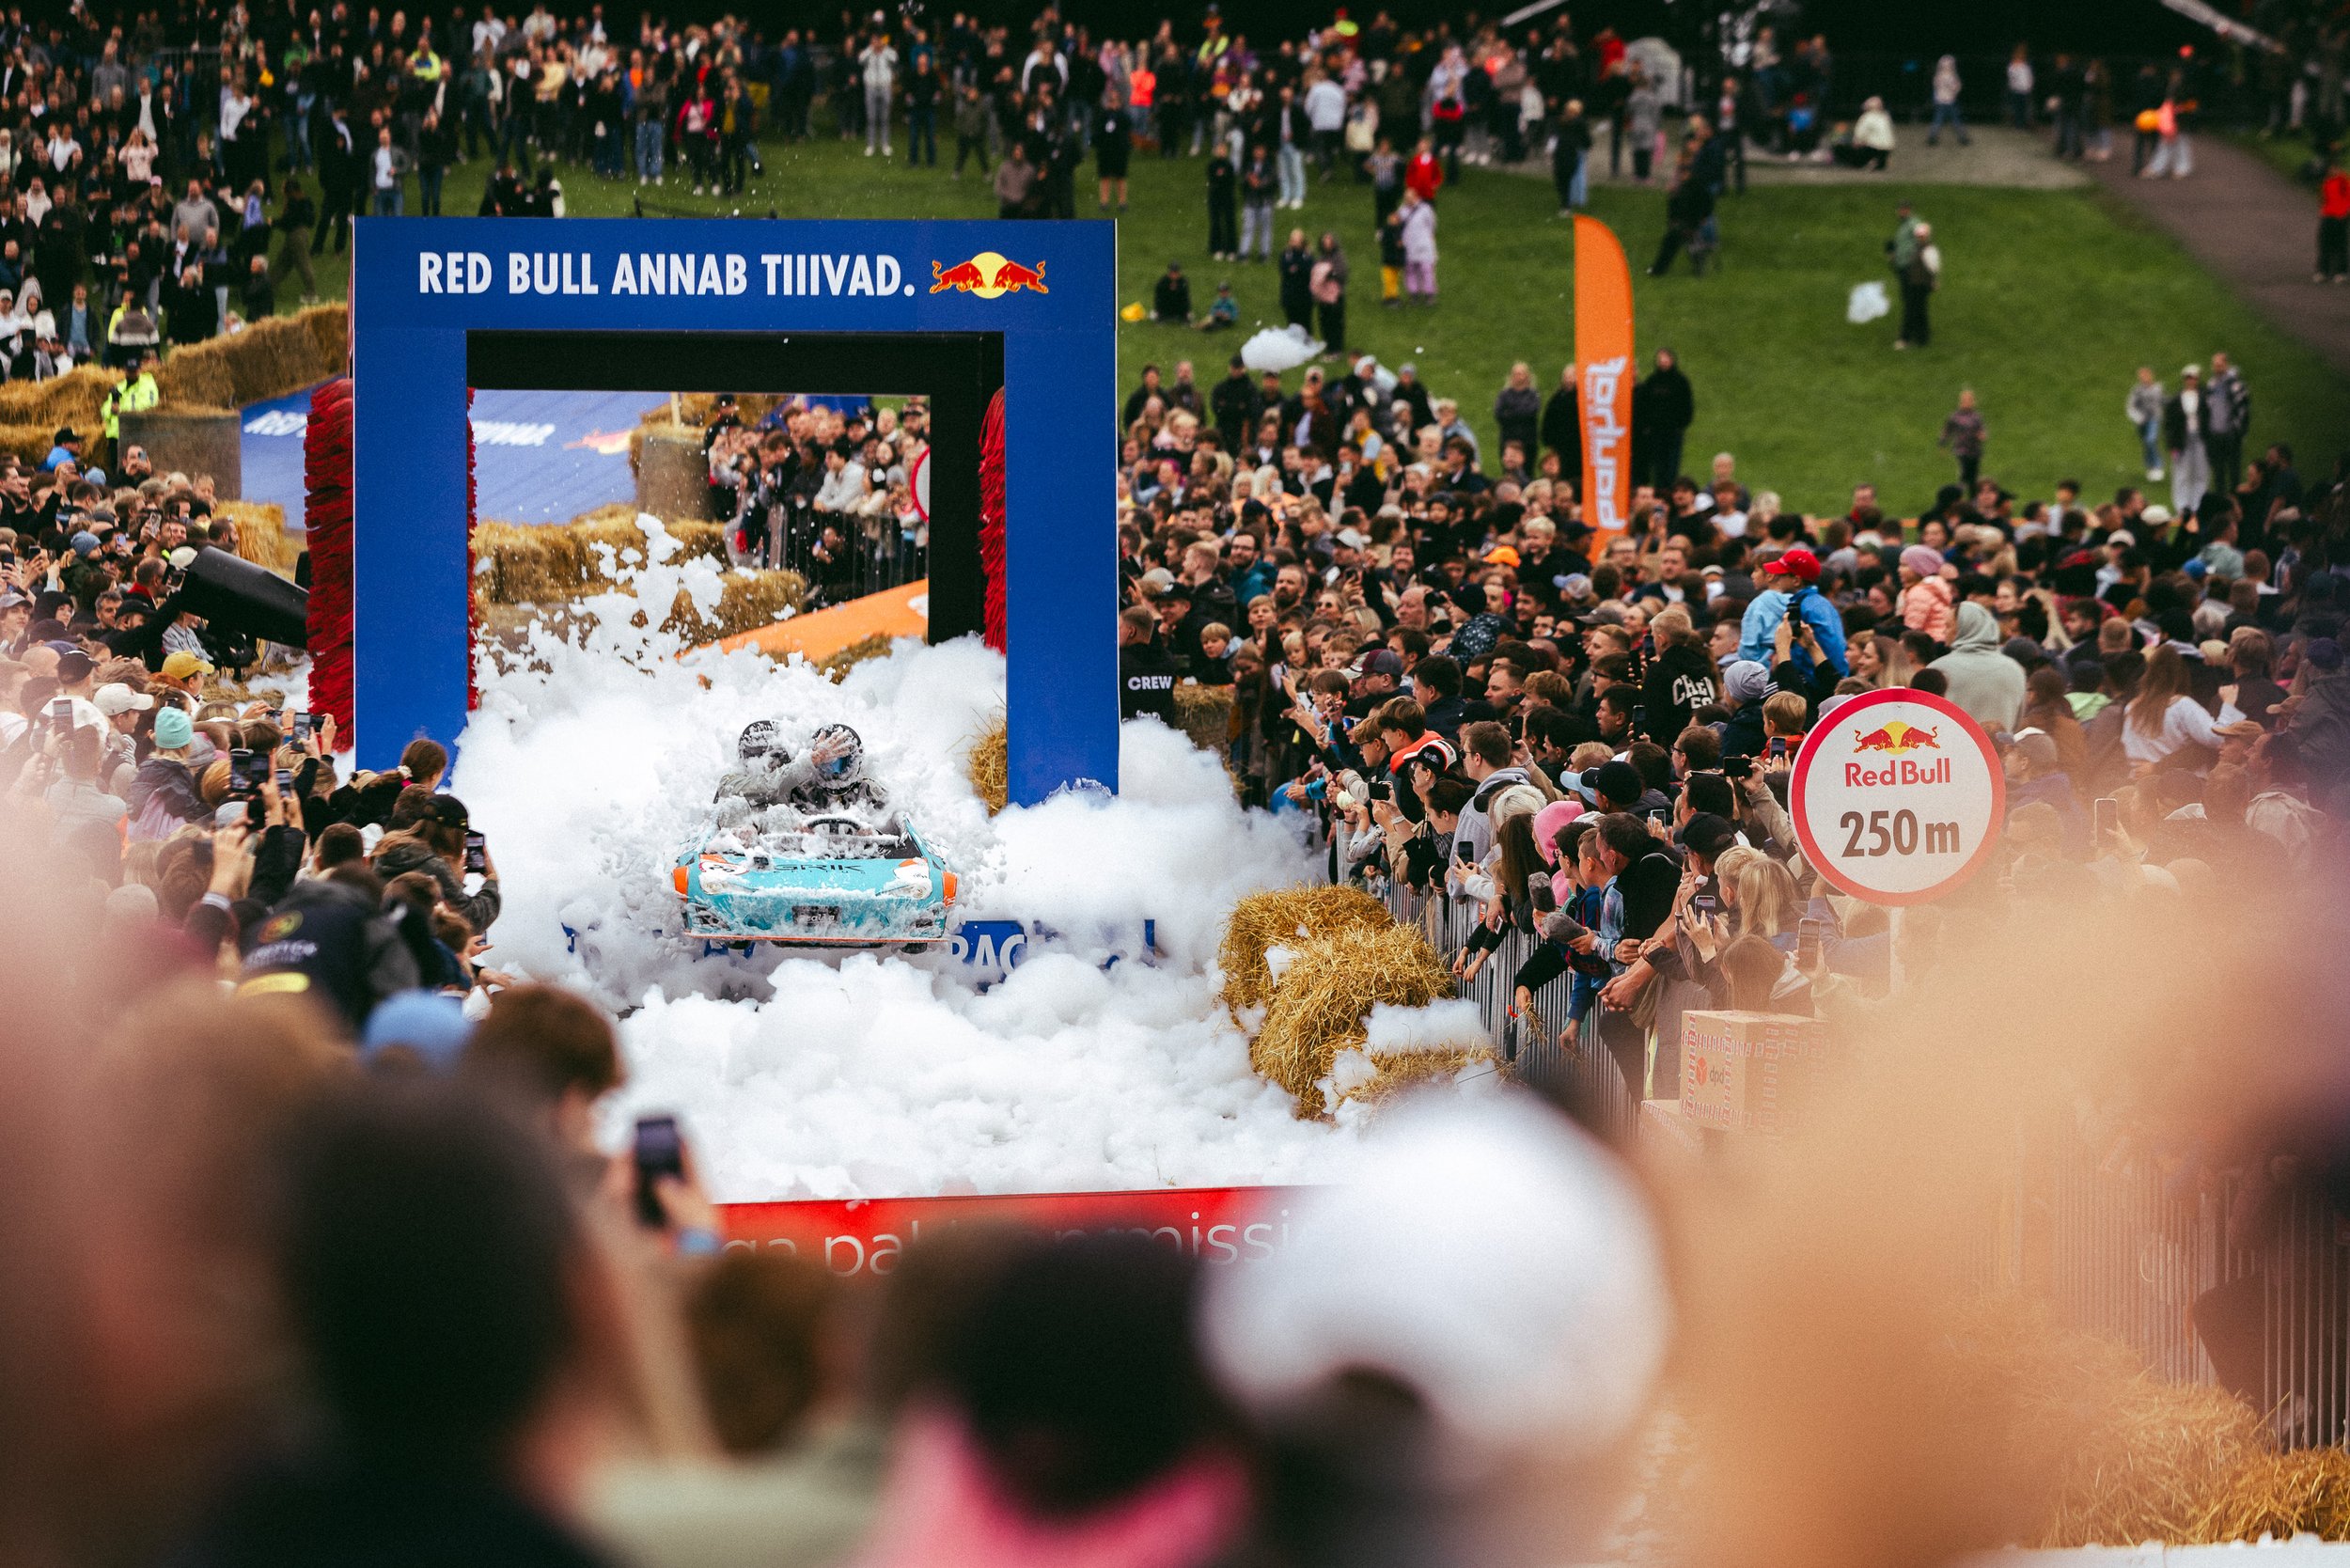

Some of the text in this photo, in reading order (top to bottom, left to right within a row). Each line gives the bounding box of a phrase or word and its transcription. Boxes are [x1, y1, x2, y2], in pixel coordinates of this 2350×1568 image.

[419, 252, 916, 297] RED BULL ANNAB TIIIVAD.
[1127, 675, 1173, 691] CREW
[1844, 757, 1951, 788] Red Bull
[1840, 808, 1961, 857] 250 m
[1708, 1064, 1726, 1087] dpd
